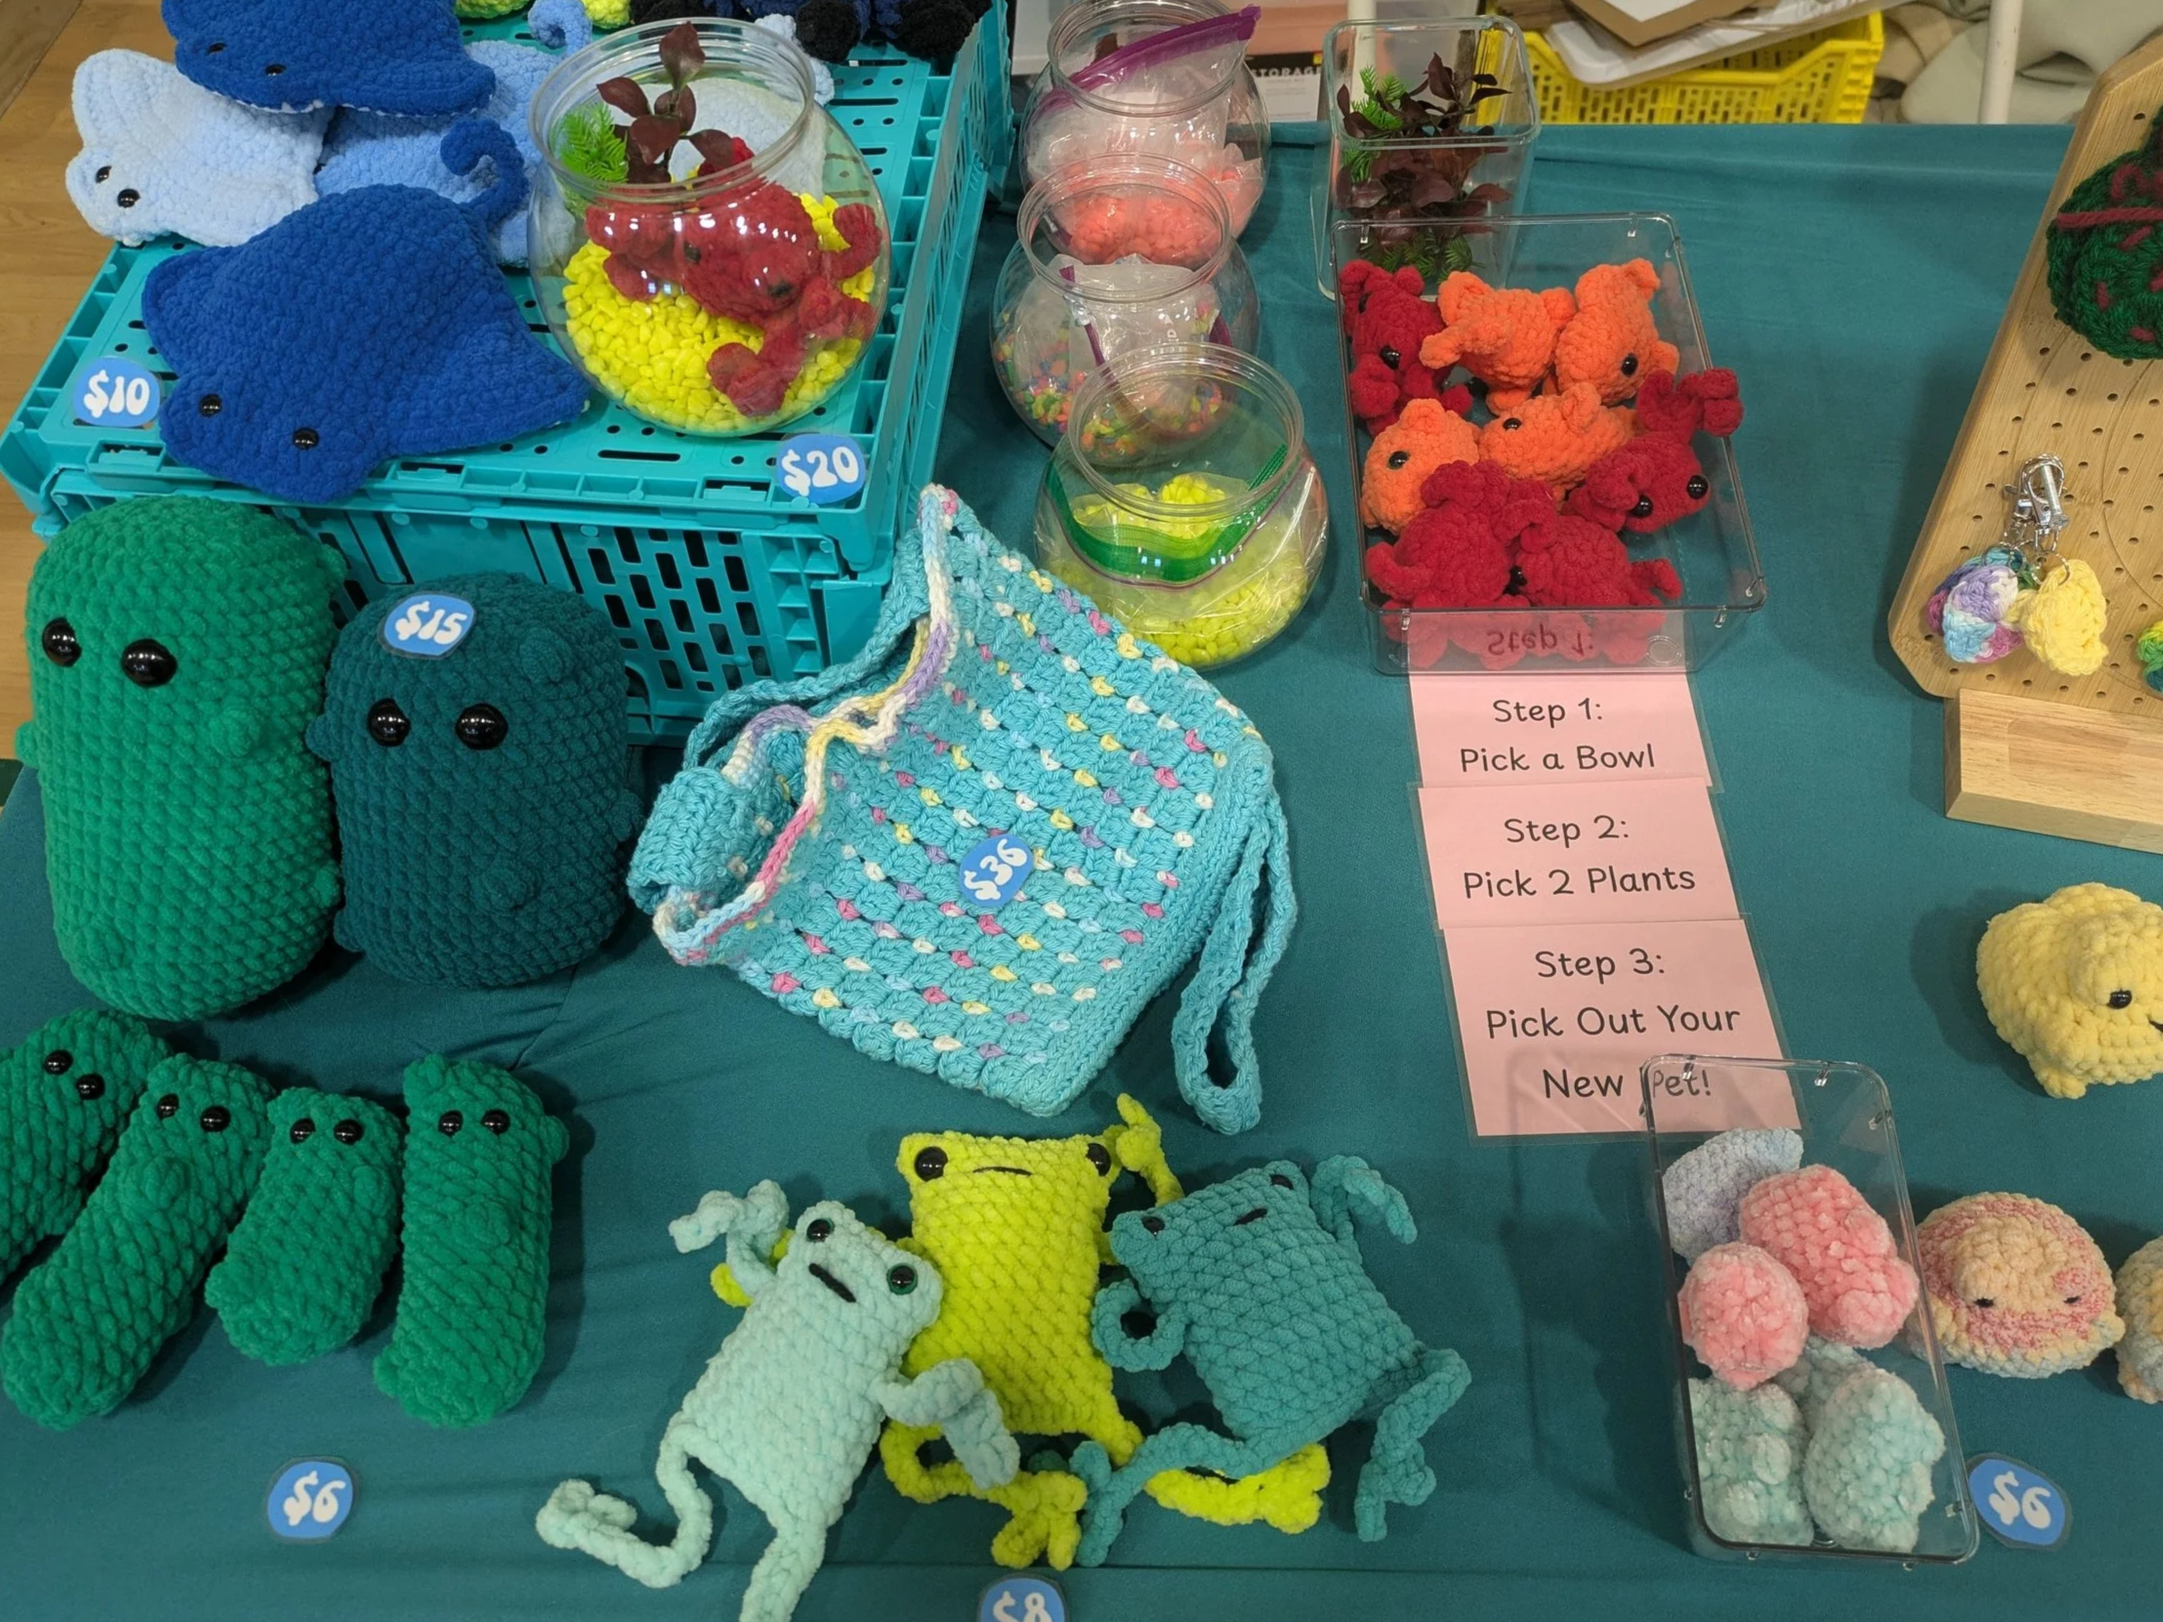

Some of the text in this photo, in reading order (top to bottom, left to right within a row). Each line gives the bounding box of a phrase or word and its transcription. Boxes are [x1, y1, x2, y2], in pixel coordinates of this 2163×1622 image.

[83, 369, 150, 418] $10
[781, 448, 859, 497] $20
[395, 600, 467, 645] $15
[1492, 697, 1603, 728] Step 1:
[1460, 743, 1656, 773] Pick a Bowl
[1504, 814, 1629, 849] Step 2:
[963, 838, 1028, 901] $36
[1463, 865, 1696, 899] Pick 2 Plants
[1535, 947, 1665, 985] Step 3:
[1486, 1004, 1741, 1040] Pick Out Your
[1542, 1068, 1712, 1099] New Pet!
[283, 1470, 347, 1526] $6
[1988, 1471, 2052, 1528] $6
[993, 1591, 1053, 1622] $8
